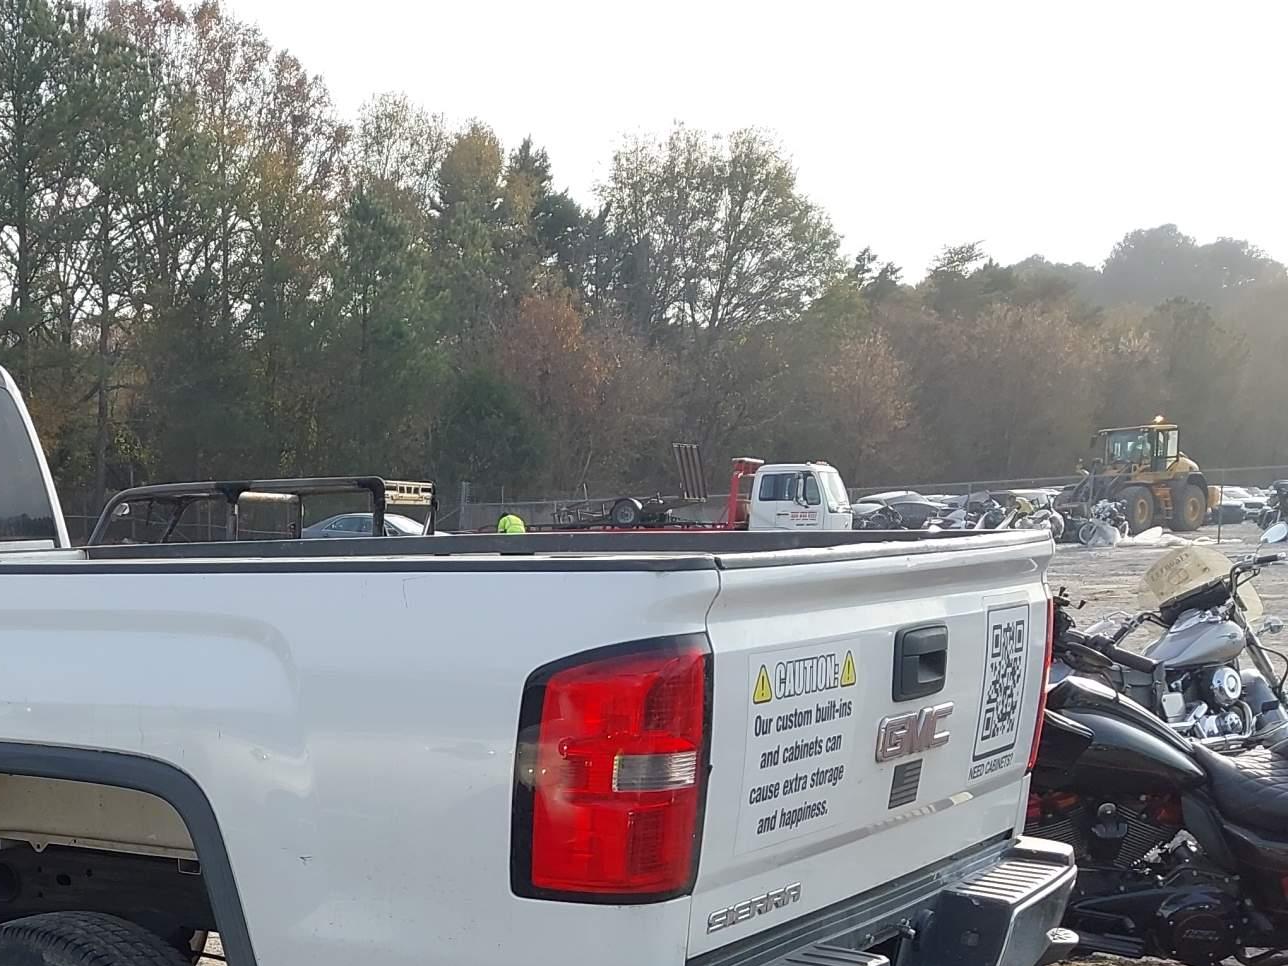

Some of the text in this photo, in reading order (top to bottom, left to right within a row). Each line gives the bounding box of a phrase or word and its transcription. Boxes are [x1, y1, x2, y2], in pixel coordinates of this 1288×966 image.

[774, 654, 839, 700] CAUTION:
[755, 698, 852, 737] Our custom built-ins
[875, 702, 954, 763] GMC
[760, 734, 842, 769] and cabinets can
[749, 765, 844, 805] cause extra storage
[968, 763, 984, 781] NEED
[757, 800, 828, 835] and happiness.
[707, 882, 802, 934] SIERRA
